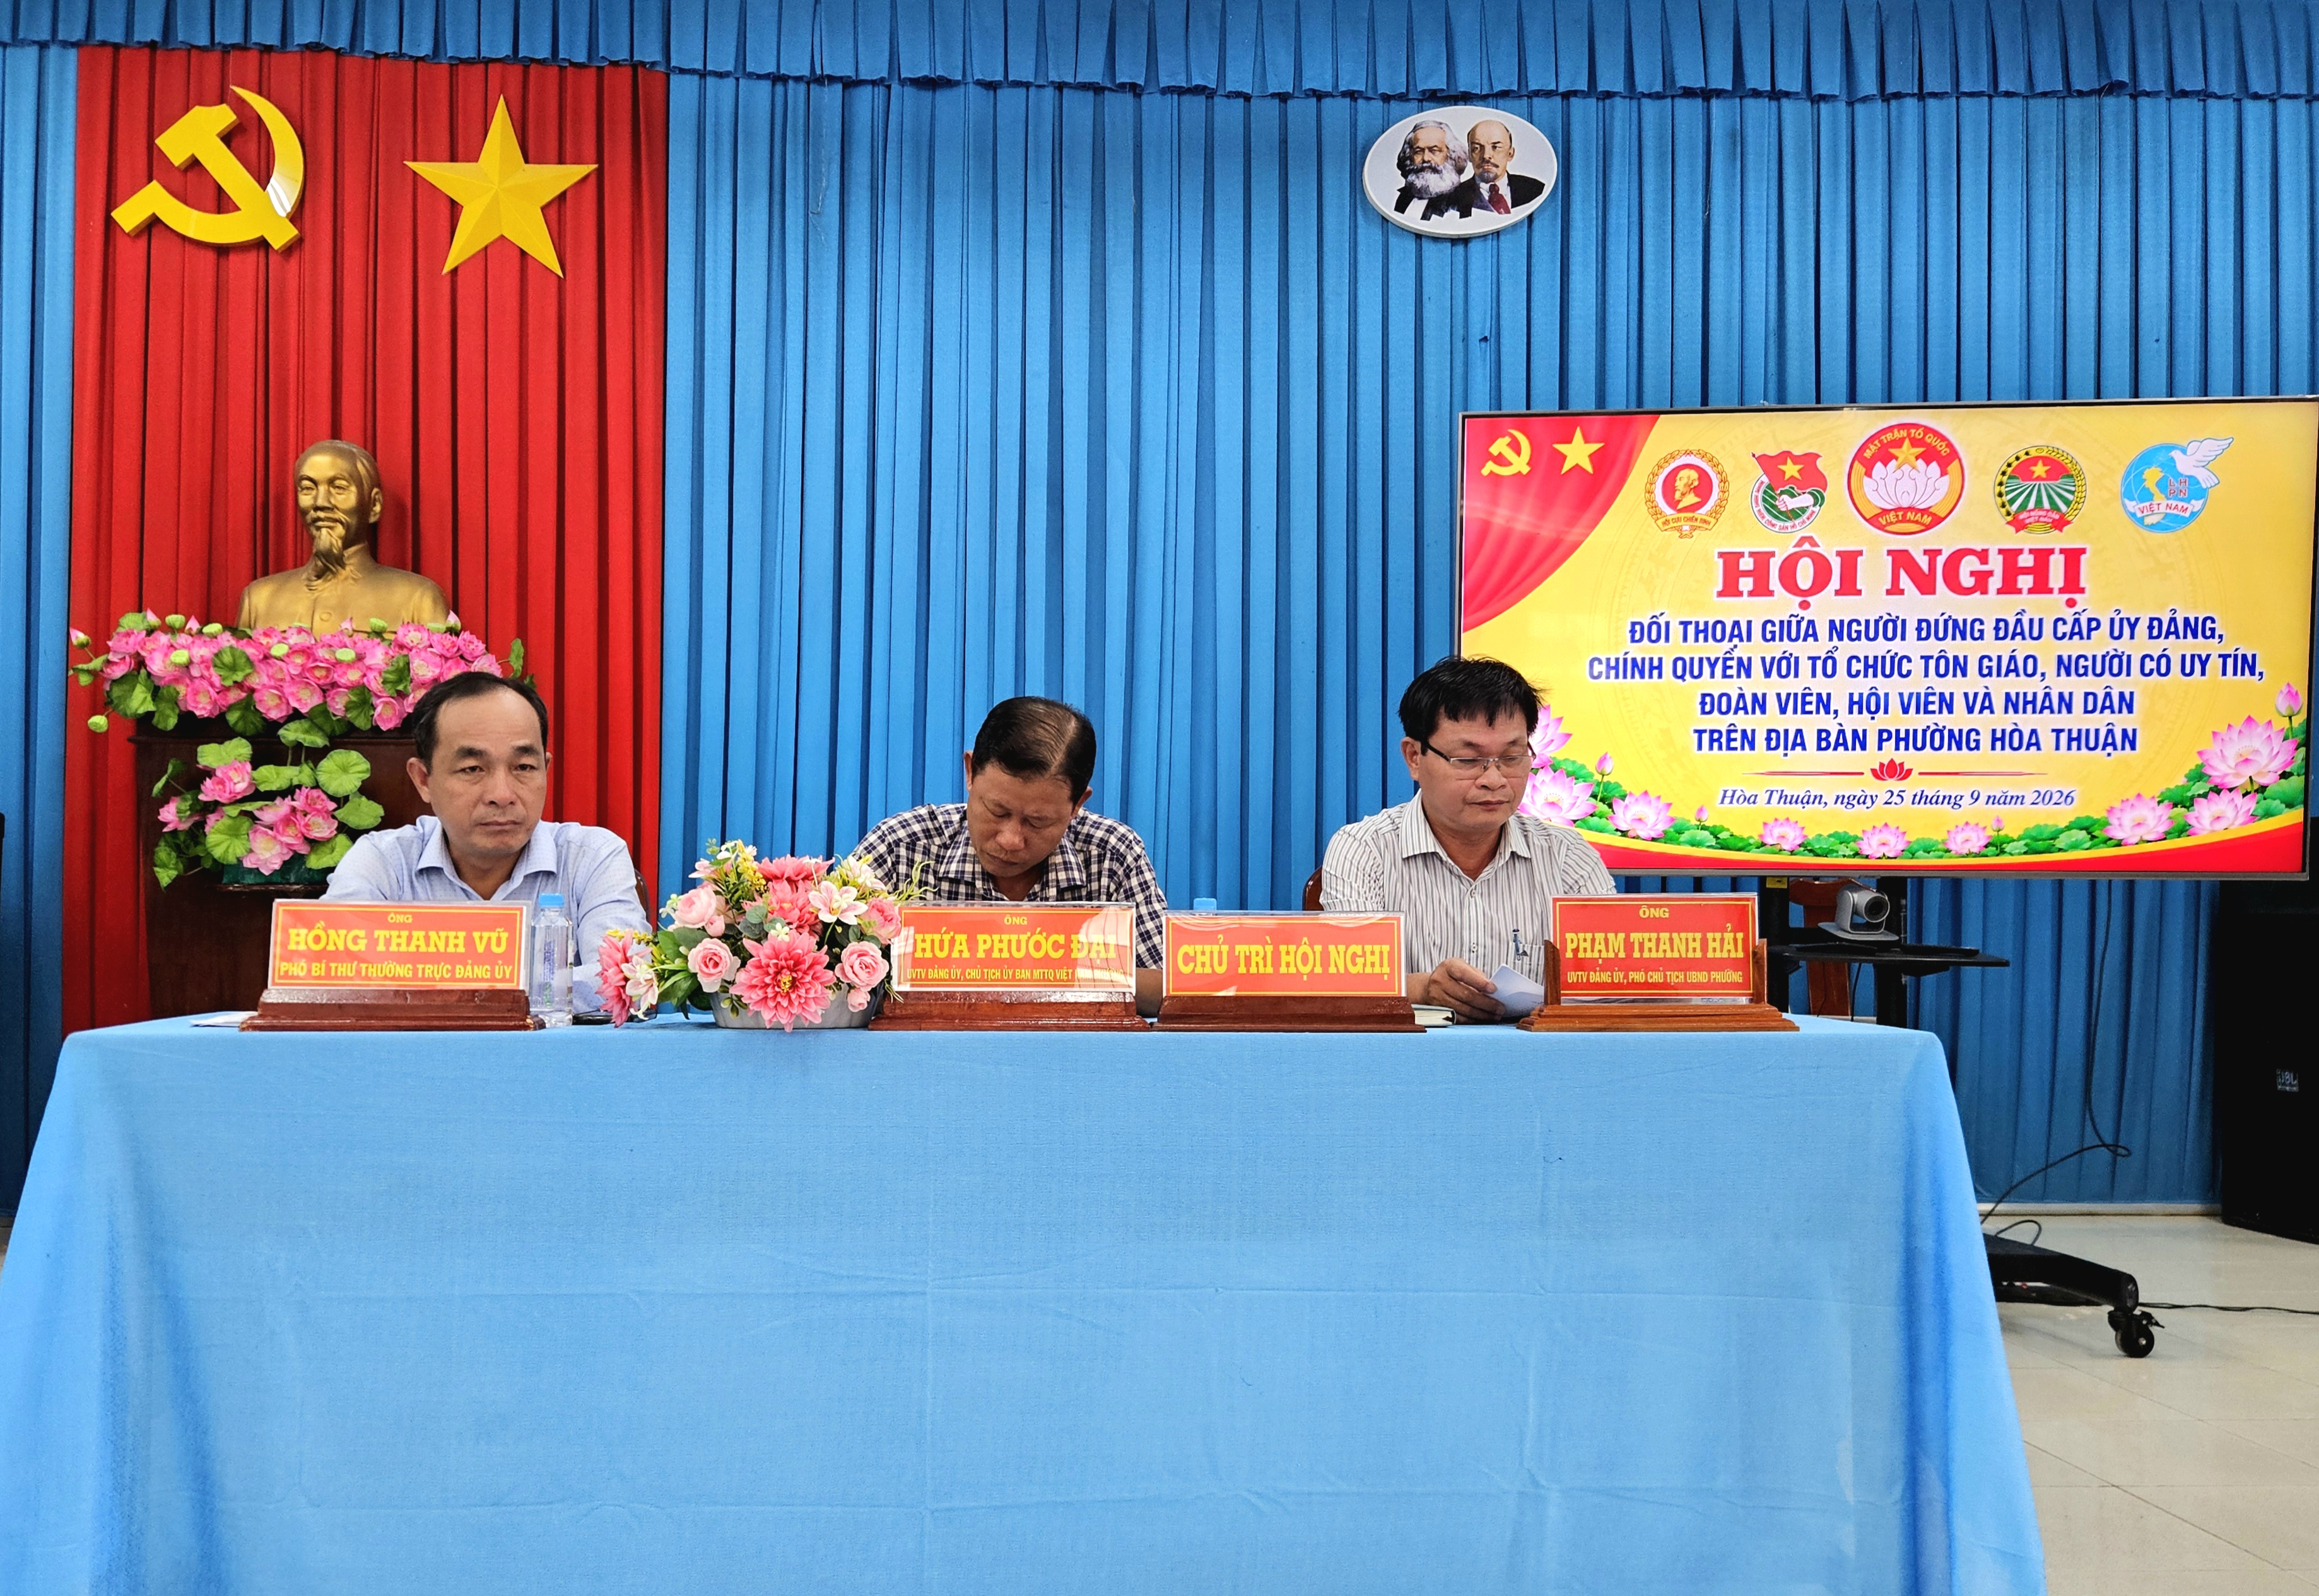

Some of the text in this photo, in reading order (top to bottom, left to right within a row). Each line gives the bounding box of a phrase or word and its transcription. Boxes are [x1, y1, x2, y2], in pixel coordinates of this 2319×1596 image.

[1863, 440, 1882, 459] MẶT
[1880, 428, 1907, 443] TRẬN
[1878, 511, 1932, 525] VIỆT NAM
[2138, 503, 2188, 515] VIỆT NAM
[1717, 536, 2087, 611] HỘI NGHỊ
[1629, 608, 2225, 648] ĐỐI THOẠI GIỮA NGƯỜI ĐỨNG ĐẦU CẤP ỦY ĐẢNG,
[1588, 646, 2265, 682] CHÍNH QUYỀN VỚI TỔ CHỨC TÔN GIÁO, NGƯỜI CÓ UY TÍN,
[1699, 686, 2135, 721] ĐOÀN VIÊN, HỘI VIÊN VÀ NHÂN DÂN
[1693, 722, 2138, 758] TRÊN ĐỊA BÀN PHƯỜNG HÒA THUẬN
[1718, 789, 2077, 811] Hòa Thuận, ngày 25 tháng 9 năm 2026
[387, 912, 413, 924] ÔNG
[1004, 914, 1028, 925] ÔNG
[1639, 905, 1670, 918] ÔNG
[288, 920, 509, 954] HỒNG THANH VŨ
[914, 927, 1117, 965] HỨA PHƯỚC ĐẠI
[1565, 923, 1744, 965] PHẠM THANH HẢI
[279, 959, 513, 980] PHÓ BÍ THƯ THƯỜNG TRỰC ĐẢNG ỦY
[1177, 934, 1390, 981] CHỦ TRÌ HỘI NGHỊ
[907, 968, 926, 980] UVTV
[927, 965, 949, 980] ĐẢNG
[951, 965, 964, 982] ỦY,
[965, 965, 981, 980] CHỦ
[983, 968, 1001, 982] TỊCH
[1003, 965, 1014, 980] ỦY
[1015, 968, 1031, 980] BAN
[1033, 968, 1054, 981] MTTQ
[1055, 966, 1072, 982] VIỆT
[1568, 967, 1743, 985] UVTV ĐẢNG ỦY, PHÓ CHỦ TỊCH UBND PHƯỜNG
